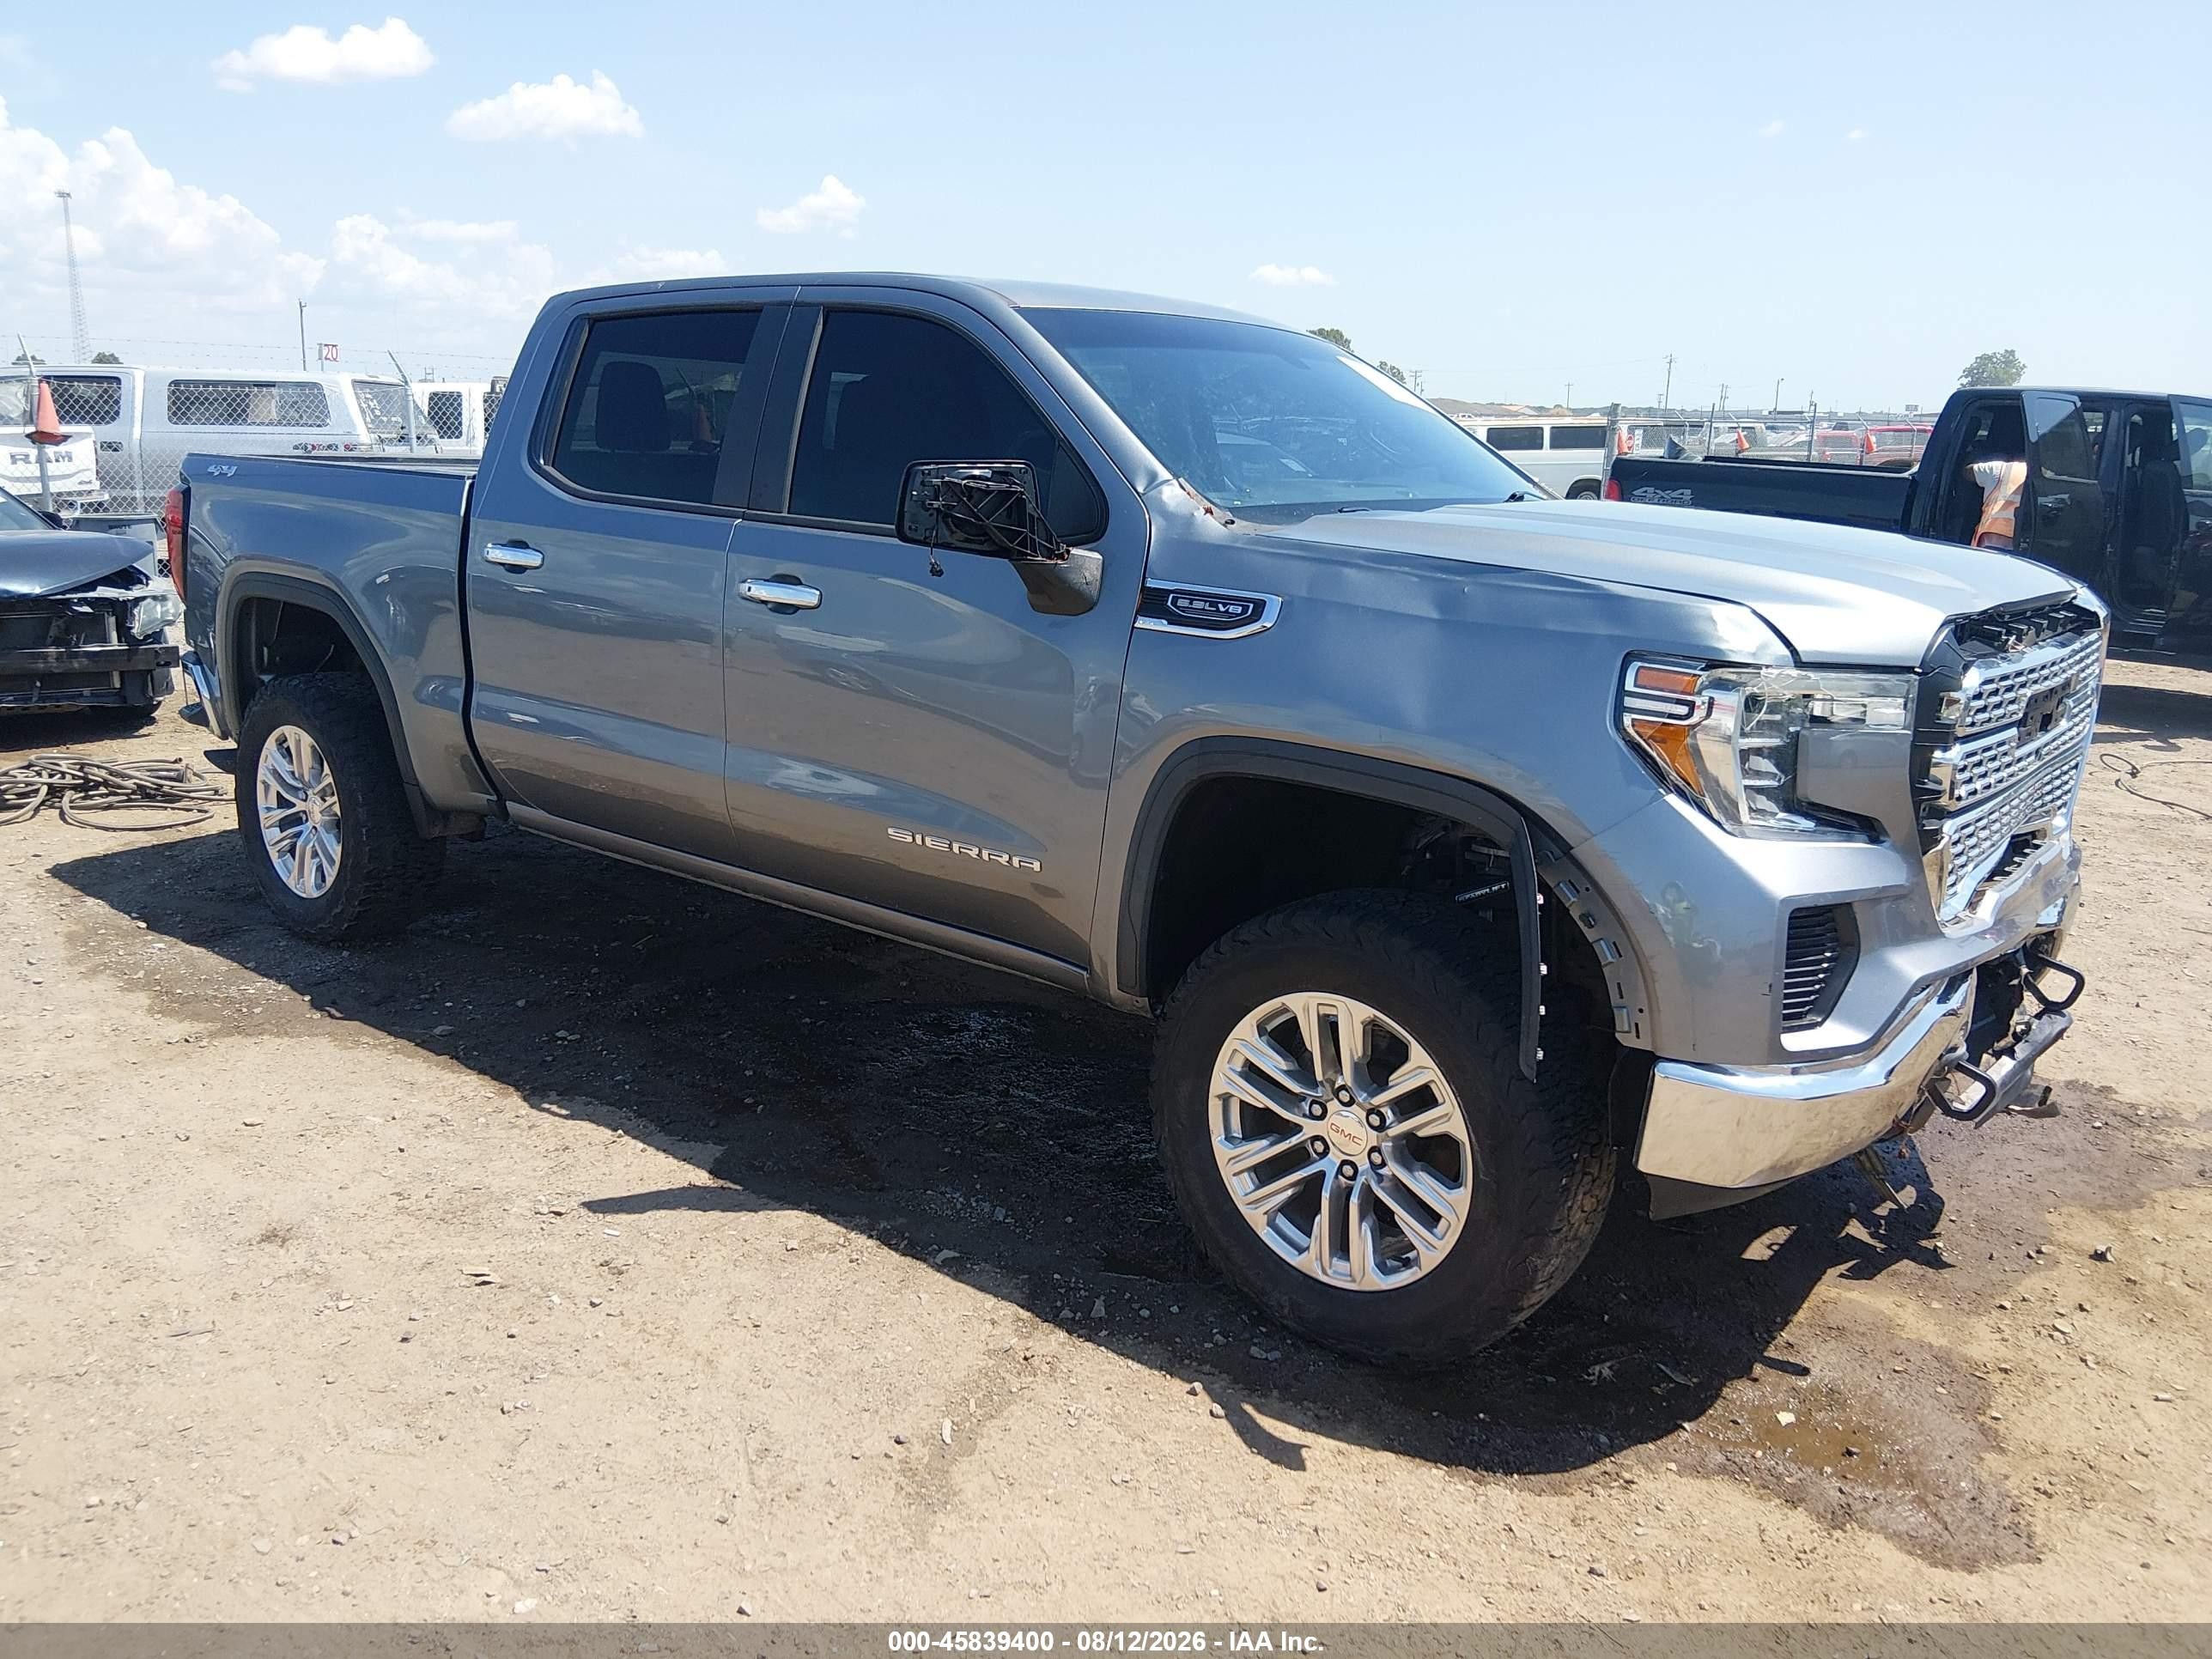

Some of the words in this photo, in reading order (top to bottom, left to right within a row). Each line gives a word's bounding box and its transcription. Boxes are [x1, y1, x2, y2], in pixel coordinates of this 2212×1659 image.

[324, 343, 339, 362] 20
[887, 827, 1042, 872] SIERRA
[1330, 1122, 1363, 1146] GMC
